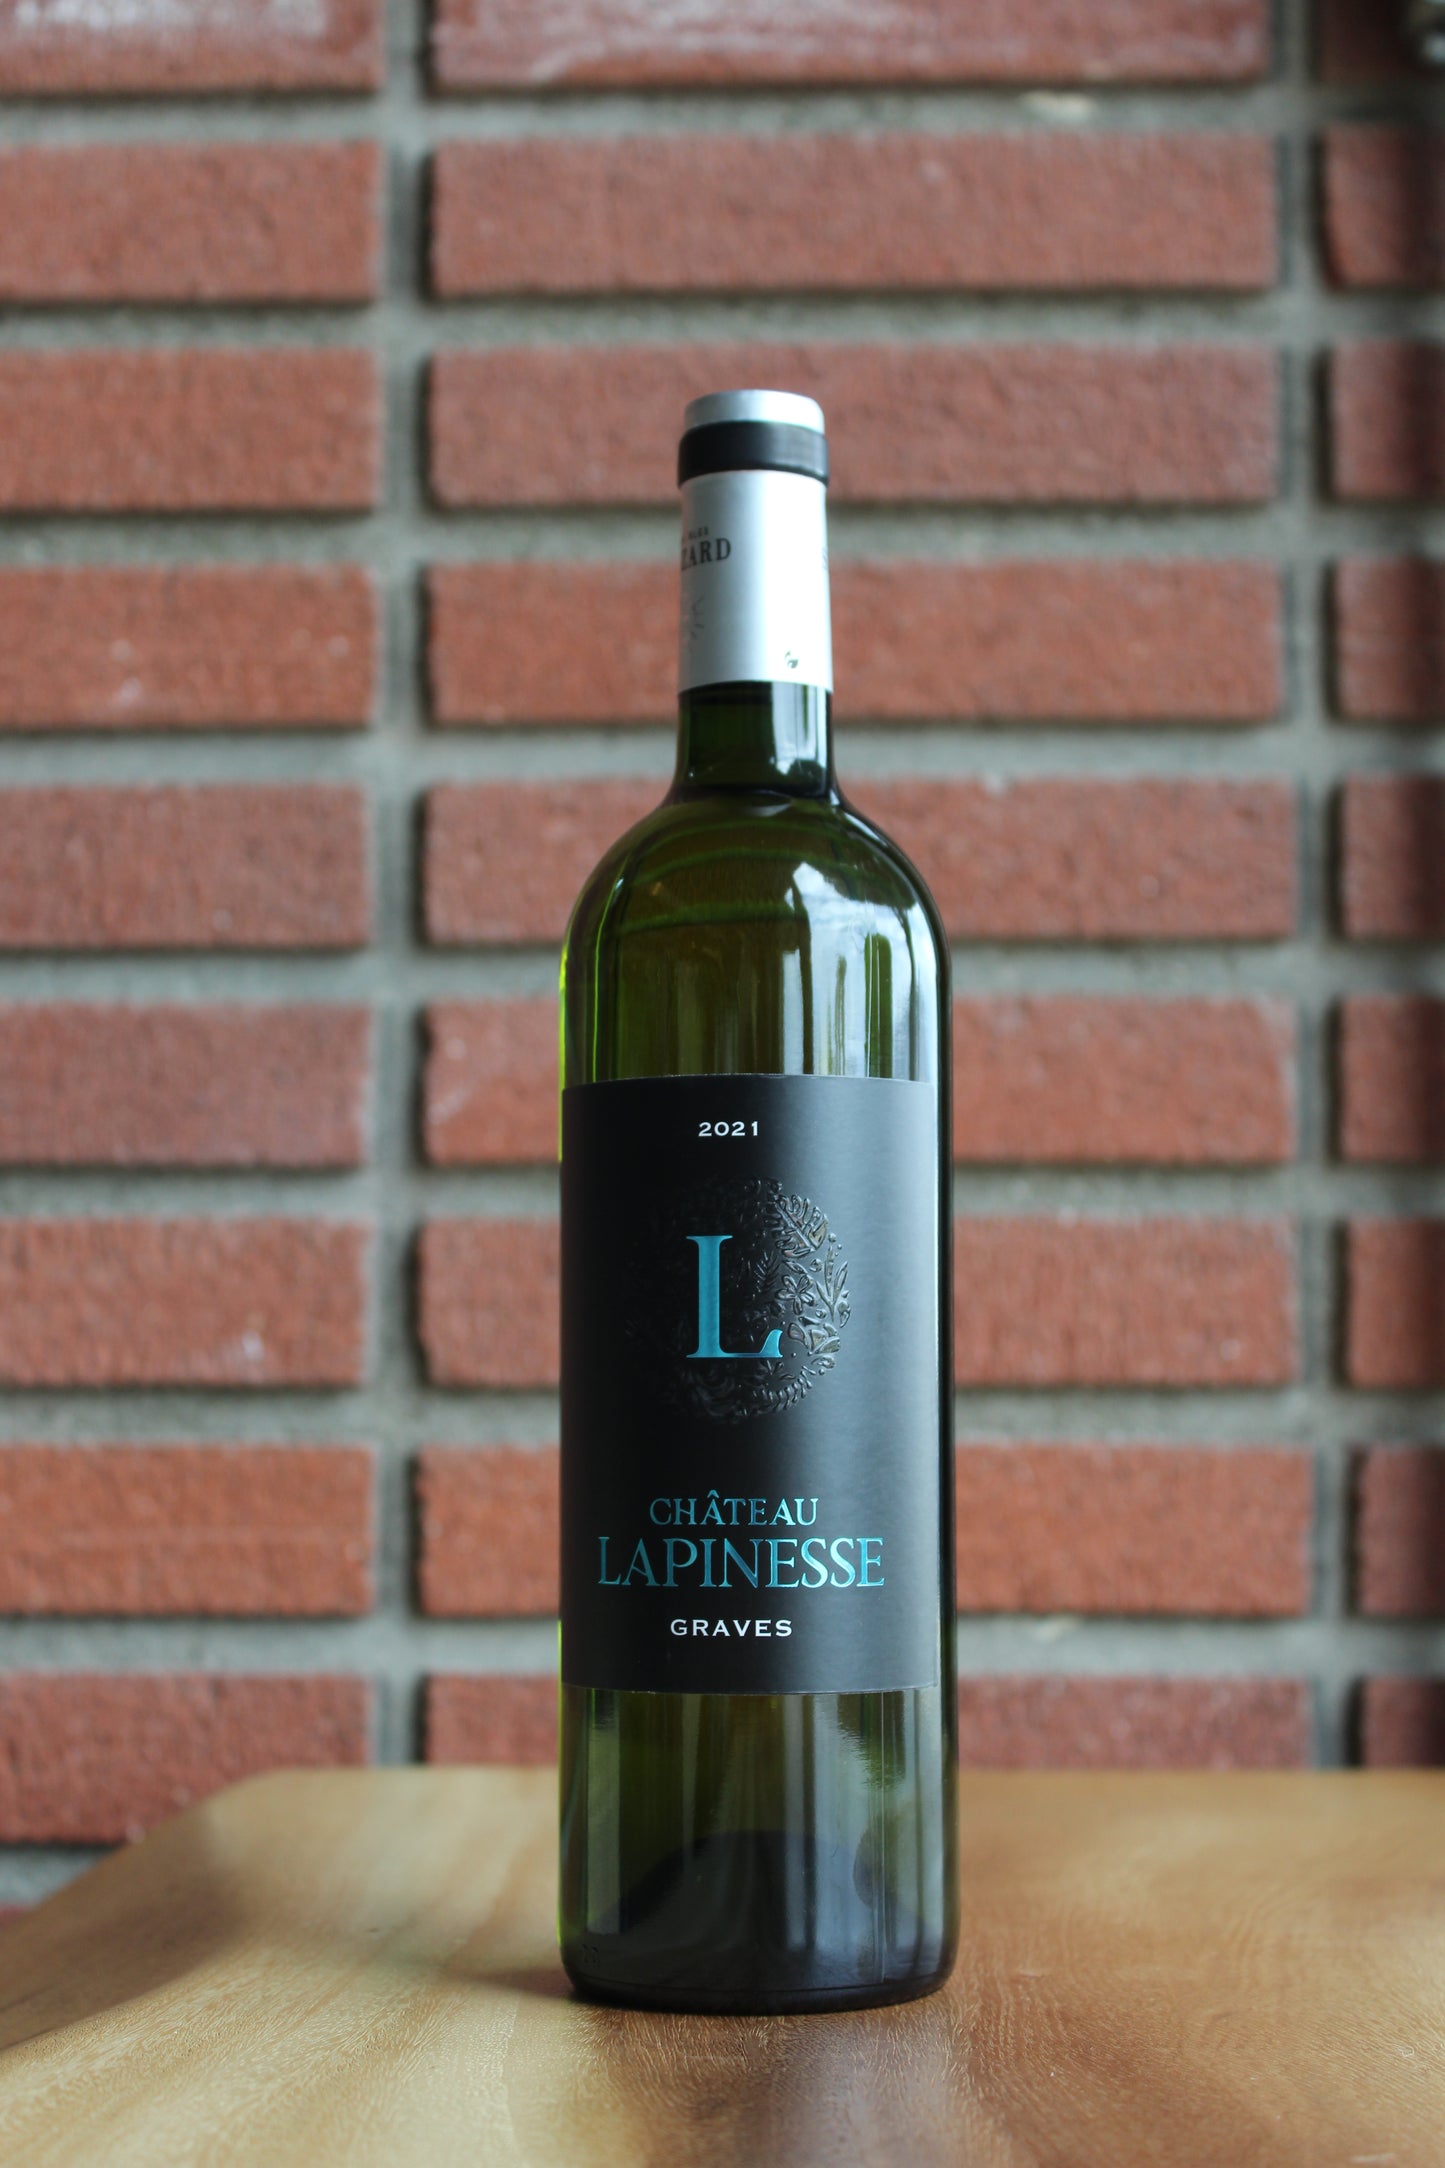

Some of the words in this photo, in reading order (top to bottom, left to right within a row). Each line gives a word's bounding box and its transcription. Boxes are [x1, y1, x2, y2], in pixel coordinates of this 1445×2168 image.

[698, 1121, 758, 1137] 2021
[686, 1235, 783, 1358] L
[650, 1490, 819, 1526] CHÂTEAU
[598, 1536, 885, 1589] LAPINESSE
[670, 1618, 793, 1637] GRAVES
